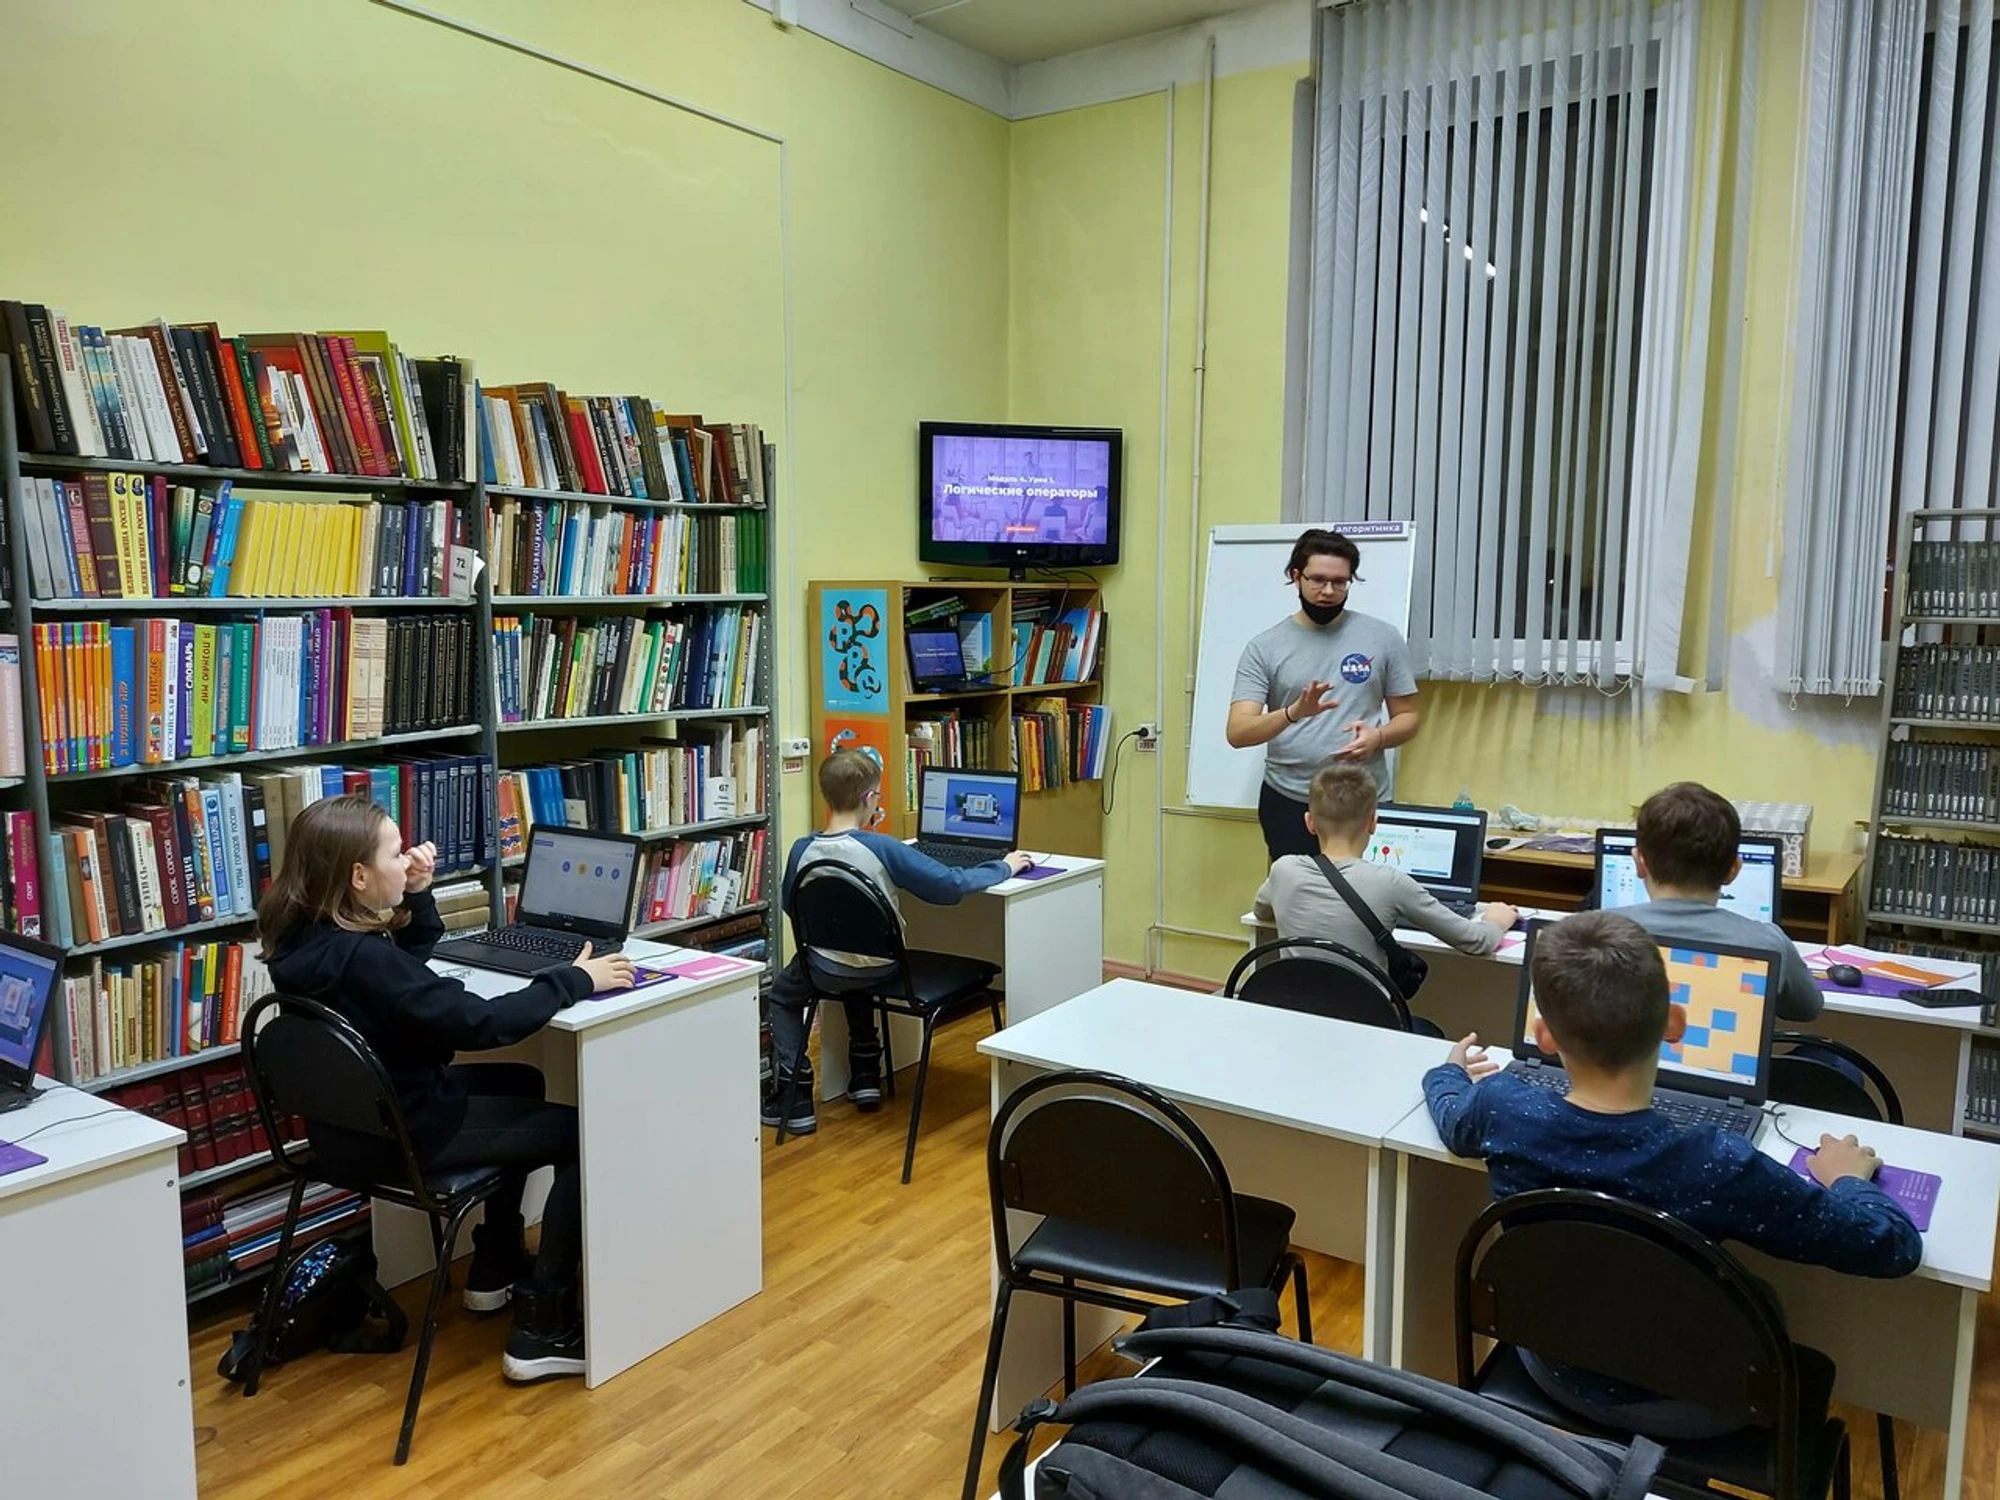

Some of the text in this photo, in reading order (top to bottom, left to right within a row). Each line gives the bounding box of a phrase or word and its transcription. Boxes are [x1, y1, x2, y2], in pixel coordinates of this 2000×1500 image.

[943, 484, 1098, 499] Логические операторы
[1336, 525, 1400, 534] алгоритмика
[456, 557, 466, 568] 72
[185, 642, 193, 690] СЛОВАРЬ
[202, 642, 210, 681] ПОЗНАЮ
[1342, 664, 1370, 673] NASA
[201, 684, 209, 705] МИР
[167, 699, 176, 758] РОССИЙСКАЯ
[719, 784, 729, 793] 67
[230, 806, 239, 833] РОССИИ
[233, 834, 242, 866] ГОРОДОВ
[164, 839, 179, 905] СОРОК СОРОКОВ
[183, 856, 197, 906] БИБЛИЯ
